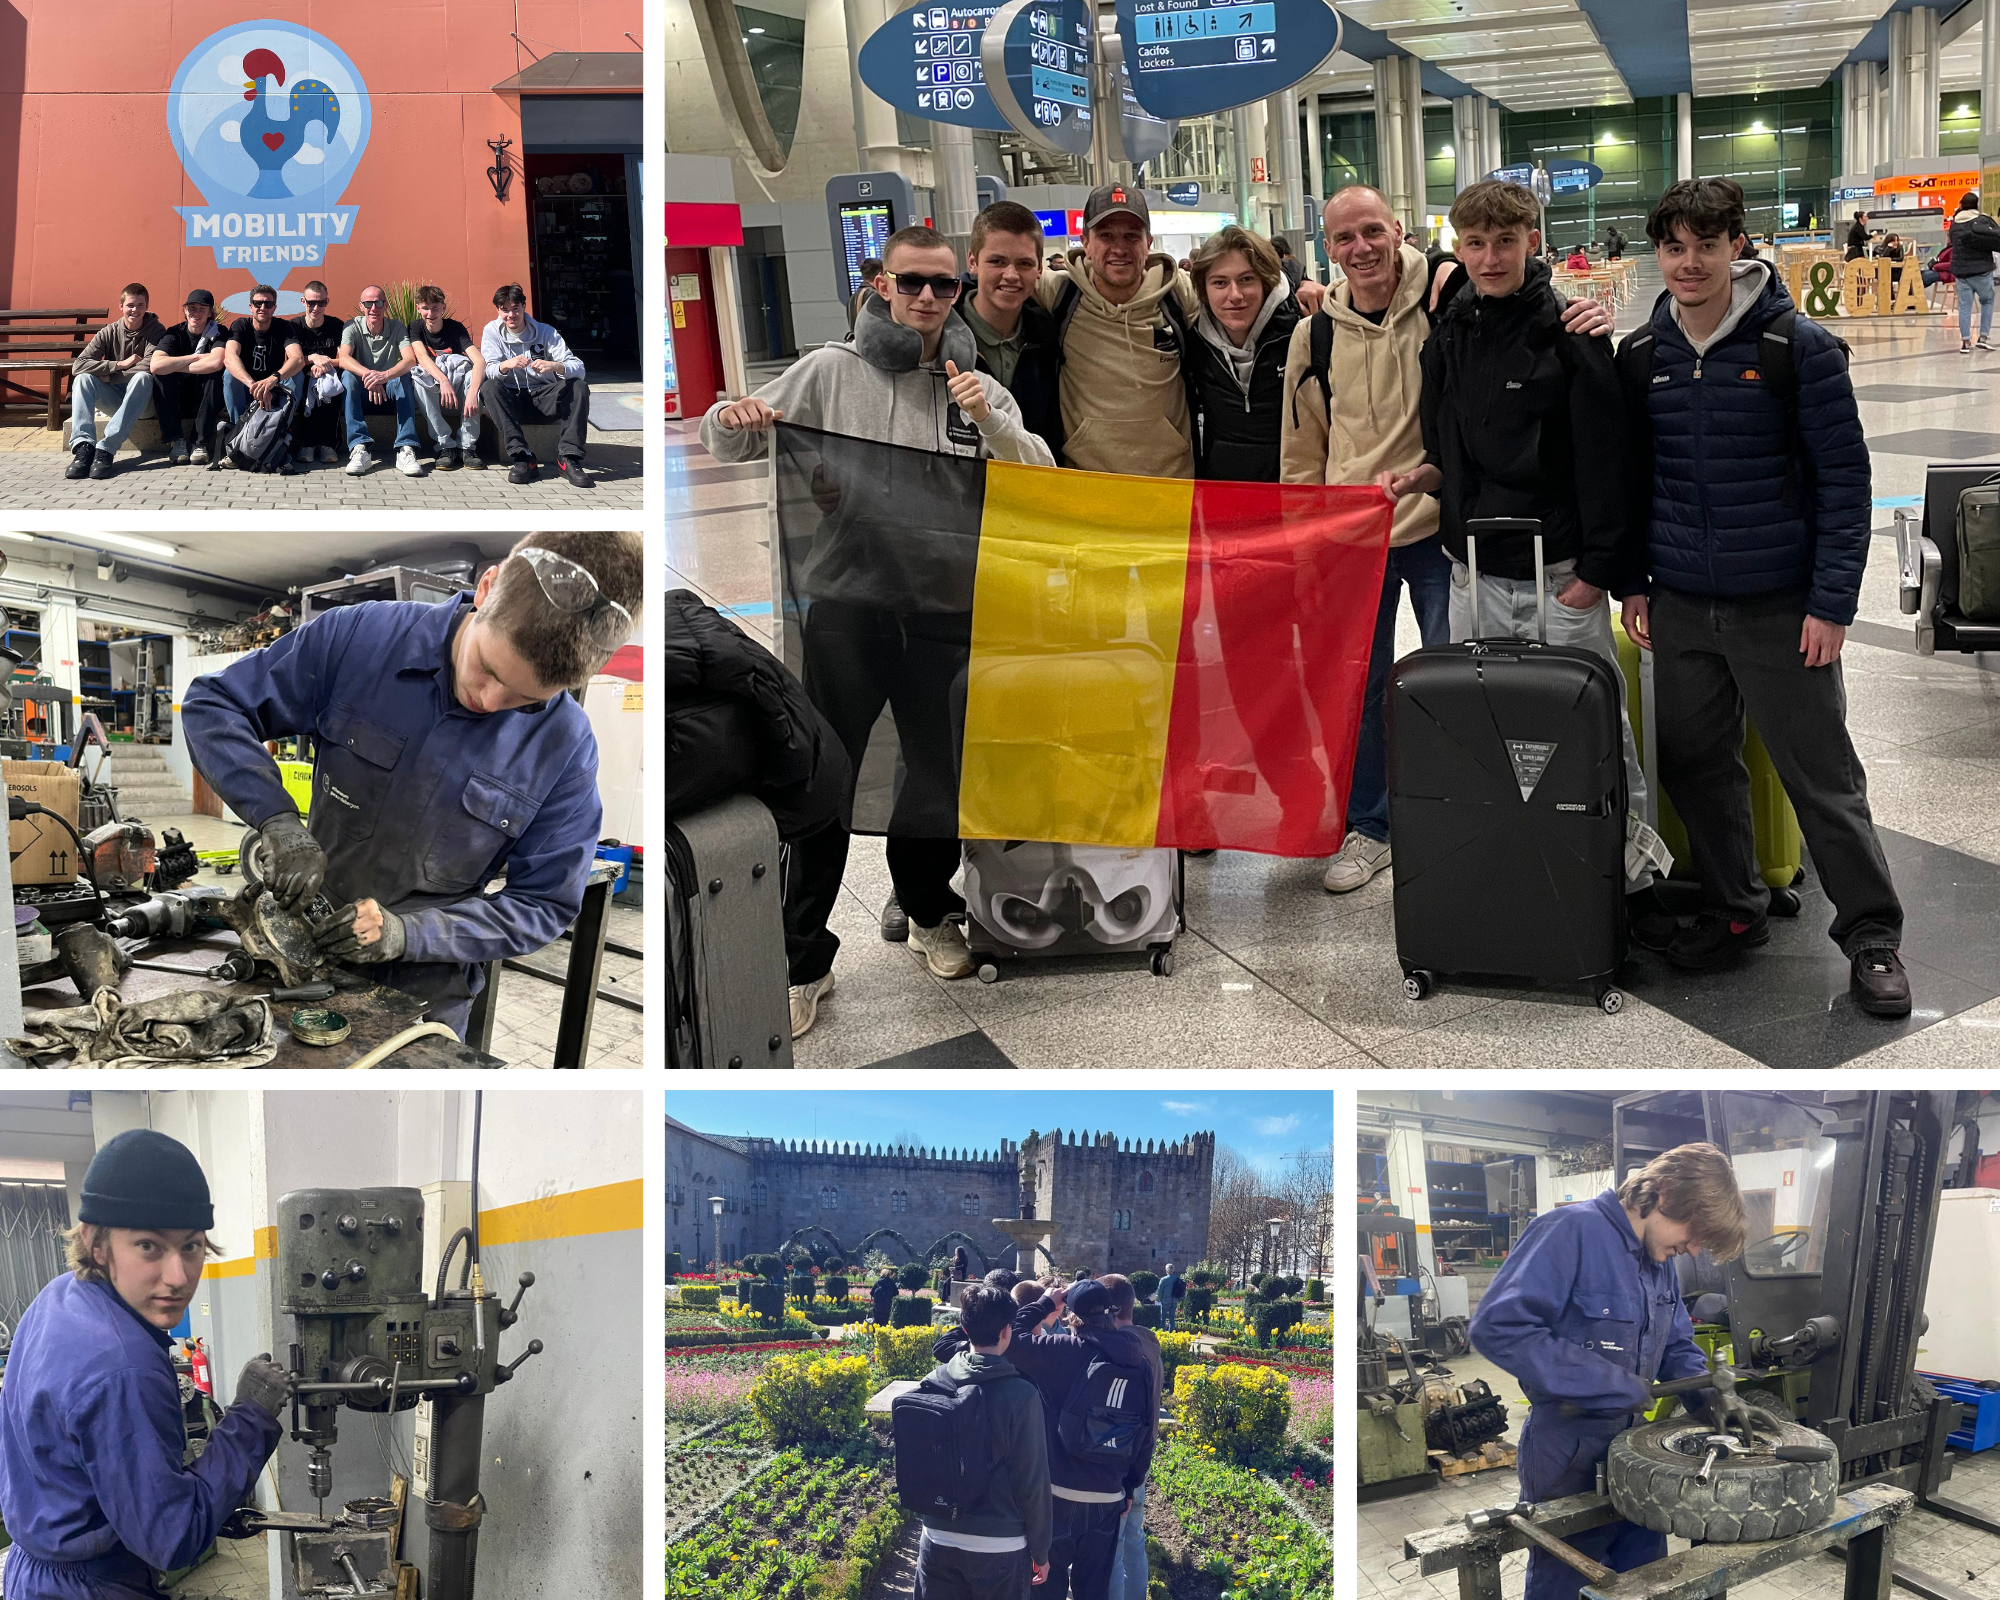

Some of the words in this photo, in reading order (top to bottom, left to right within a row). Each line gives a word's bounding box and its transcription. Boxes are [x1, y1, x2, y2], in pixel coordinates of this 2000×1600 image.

[1135, 3, 1155, 13] Lost
[1158, 1, 1165, 10] &
[1168, 0, 1199, 9] Found
[1138, 47, 1170, 57] Cacifos
[1138, 58, 1175, 69] Lockers
[1940, 178, 1956, 187] rent
[1965, 177, 1979, 185] car
[191, 213, 349, 238] MOBILITY
[222, 244, 319, 263] FRIENDS
[1805, 261, 1841, 318] &
[1844, 255, 1930, 317] CIA
[8, 784, 37, 792] EROSOLS
